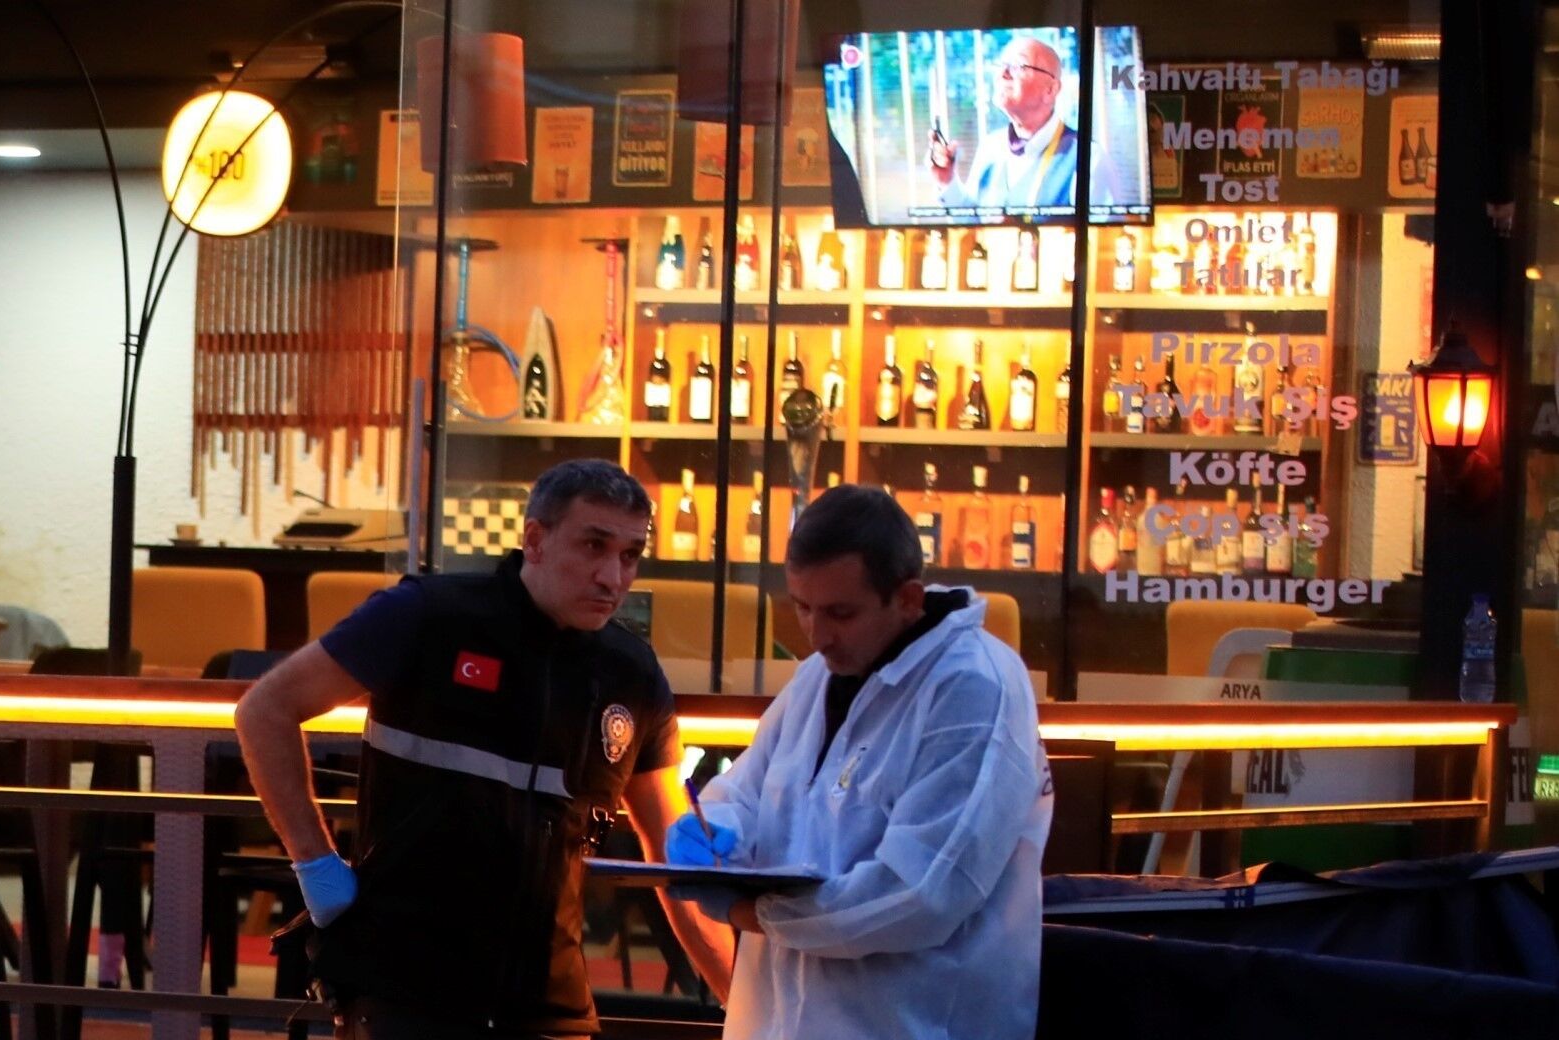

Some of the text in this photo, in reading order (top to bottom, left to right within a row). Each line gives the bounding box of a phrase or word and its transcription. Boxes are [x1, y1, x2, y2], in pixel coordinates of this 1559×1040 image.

[1162, 122, 1339, 151] Menemen
[1199, 173, 1280, 203] Tost
[1185, 217, 1293, 245] Omlet
[1150, 332, 1322, 367] Pirzola
[1112, 383, 1358, 431] Tavuk Şiş
[1168, 451, 1307, 486] Köfte
[1144, 503, 1241, 547] Çöp
[1104, 569, 1393, 614] Hamburger
[1220, 683, 1262, 700] ARYA
